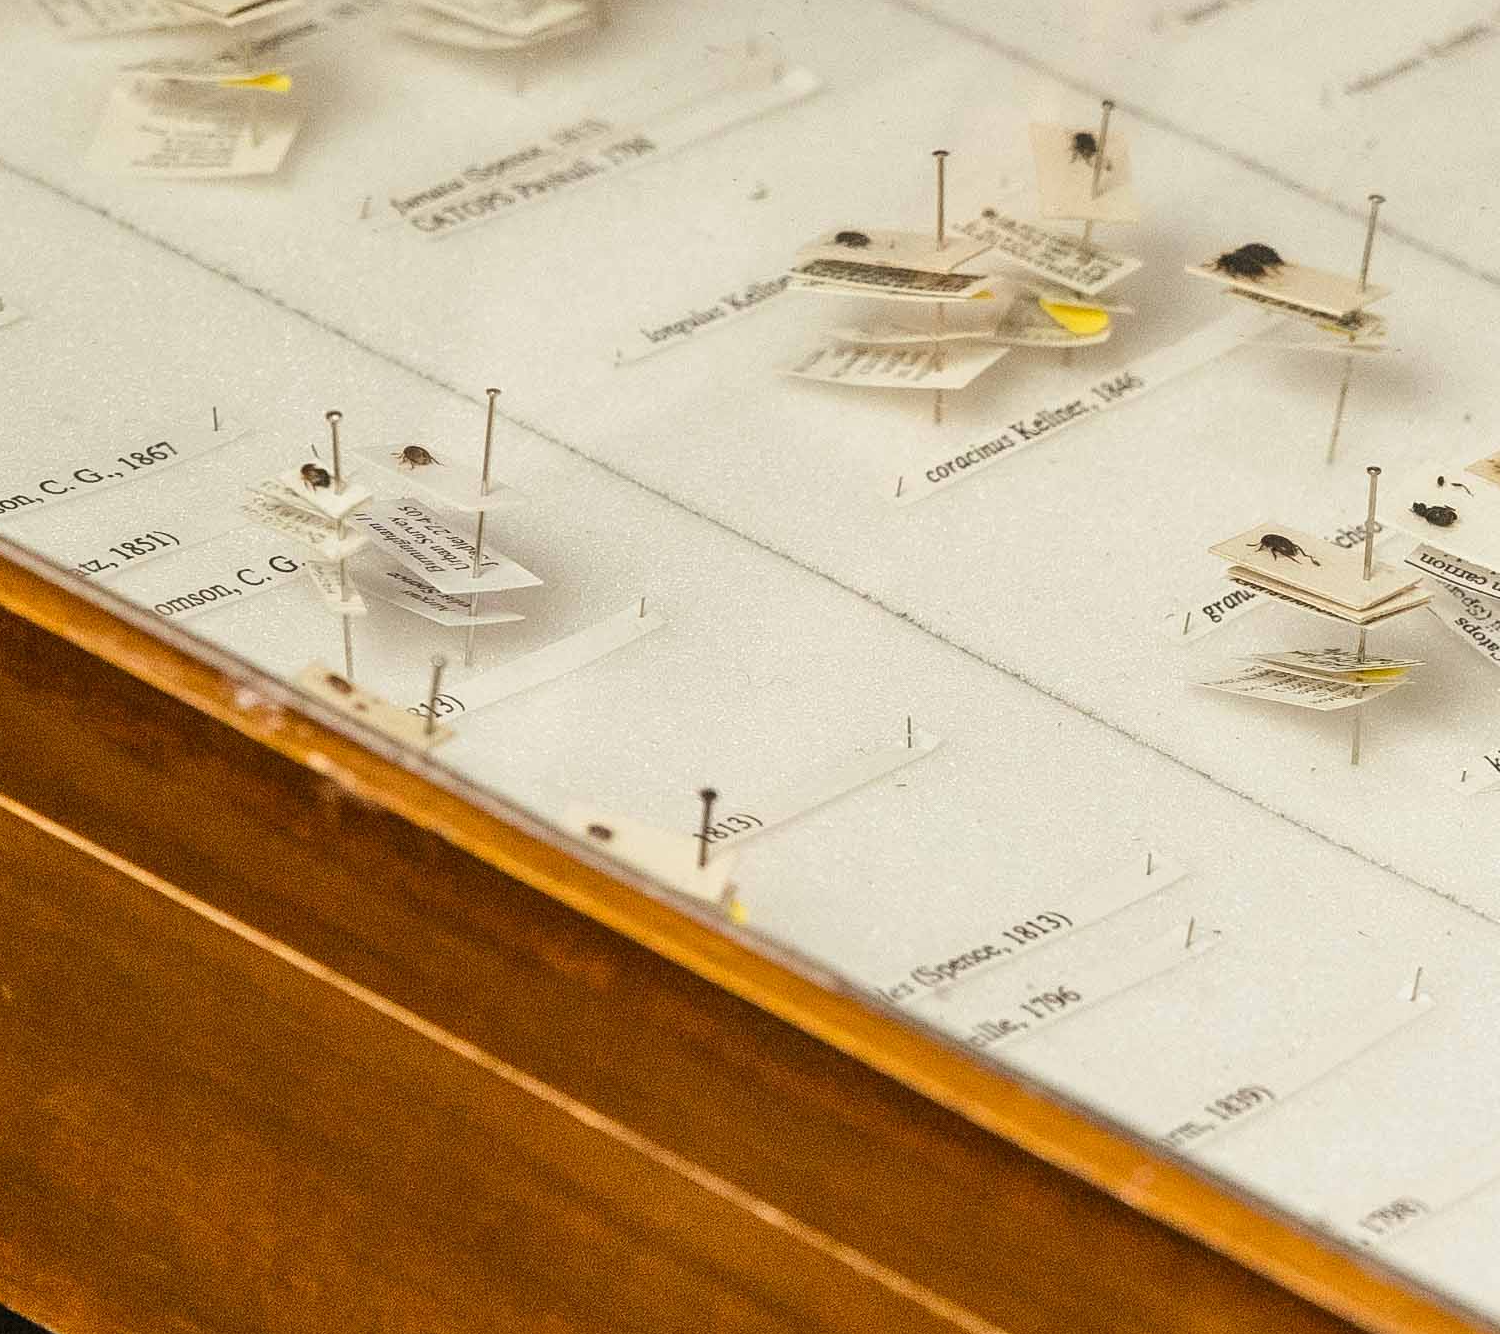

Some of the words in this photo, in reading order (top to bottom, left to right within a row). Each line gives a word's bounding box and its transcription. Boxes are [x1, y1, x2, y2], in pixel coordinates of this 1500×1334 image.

[39, 478, 76, 496] C.
[118, 440, 179, 471] 1867
[924, 432, 1016, 484] coracinus
[109, 530, 181, 562] 1851)
[370, 523, 444, 573] Birmingham
[387, 515, 433, 545] Survey
[430, 543, 470, 571] Urban
[1418, 551, 1488, 587] carrion
[236, 568, 273, 588] C.
[909, 941, 1013, 989] (Spence,
[1003, 910, 1074, 946] 1813)
[1019, 984, 1082, 1020] 1796
